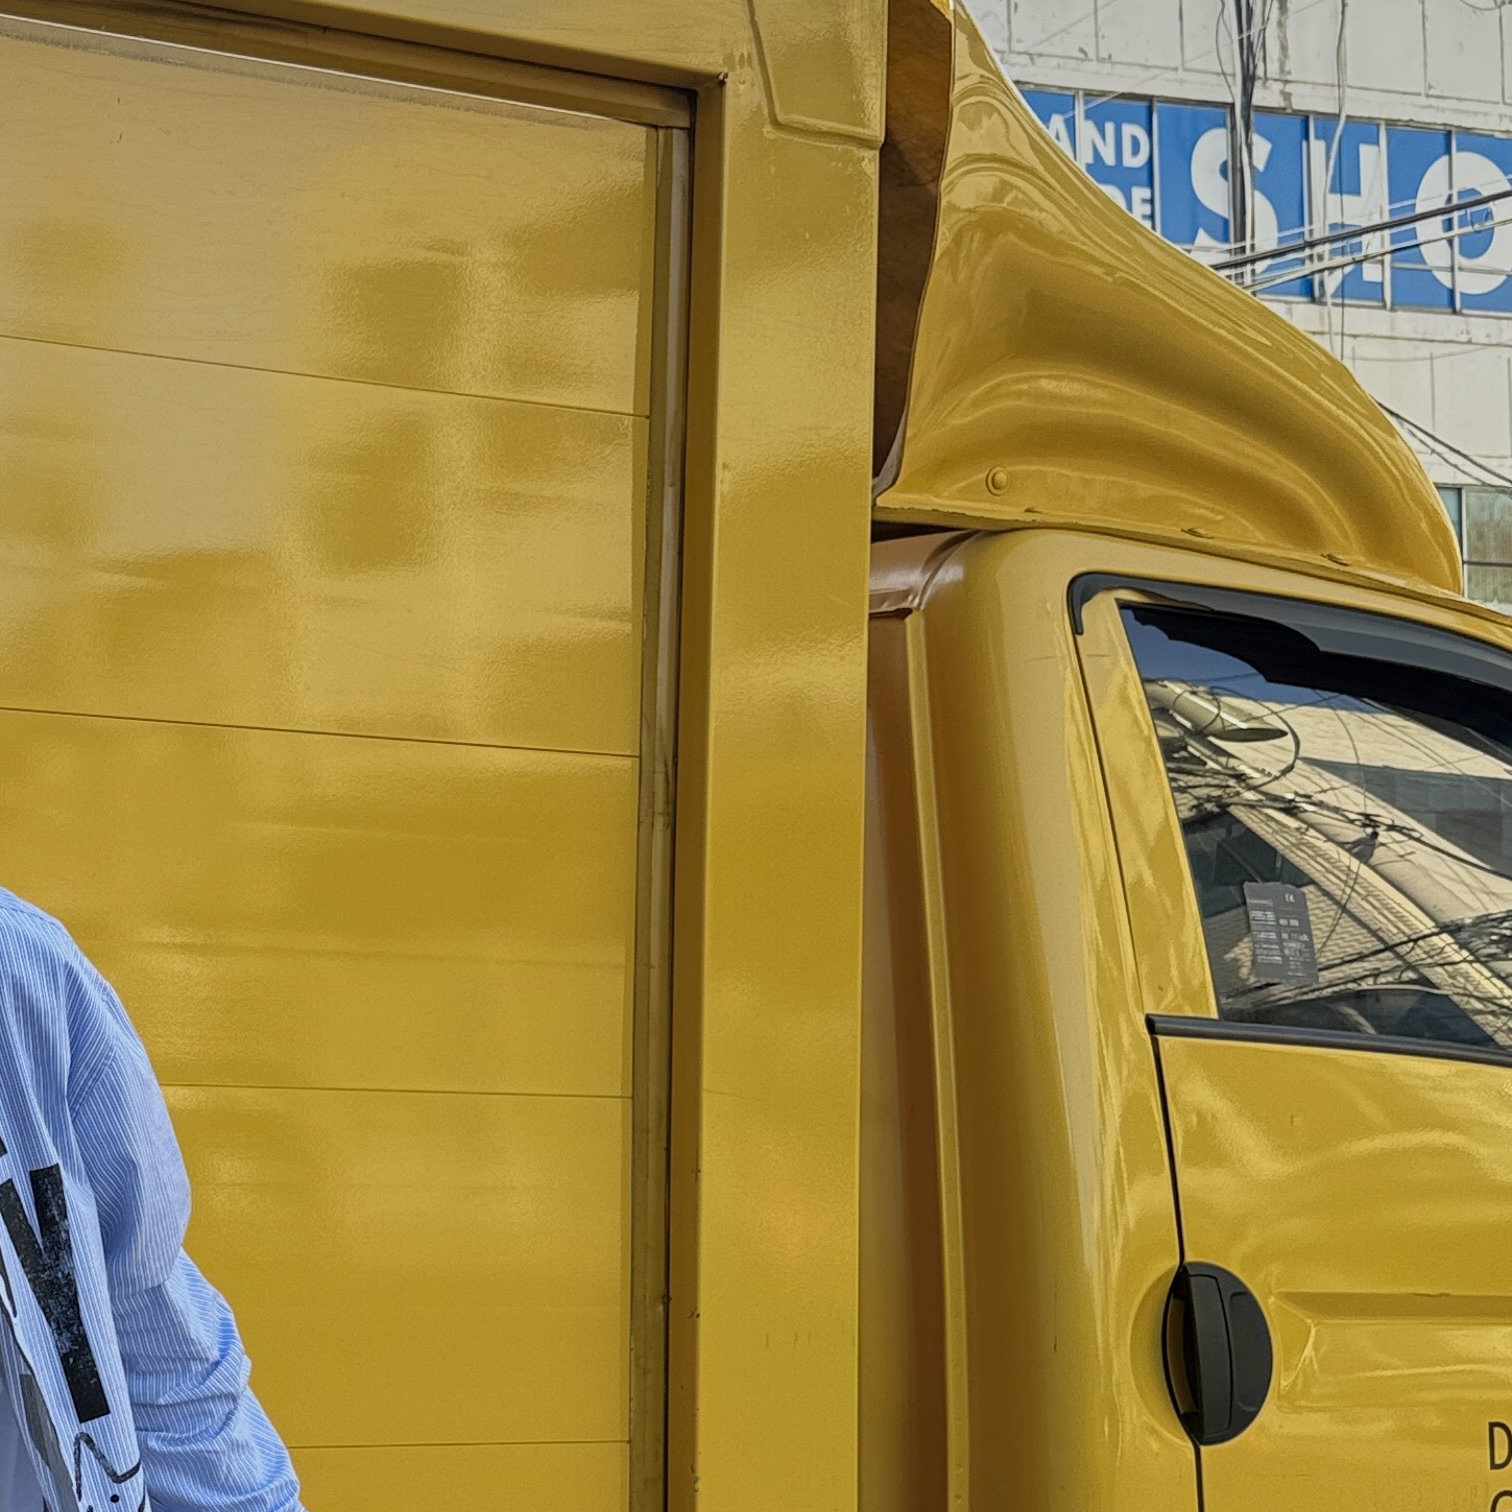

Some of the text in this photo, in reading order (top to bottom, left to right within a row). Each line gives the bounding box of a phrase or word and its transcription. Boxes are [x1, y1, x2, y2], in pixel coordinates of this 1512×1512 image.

[1048, 113, 1512, 294] AND SHO
[1098, 184, 1152, 229] E
